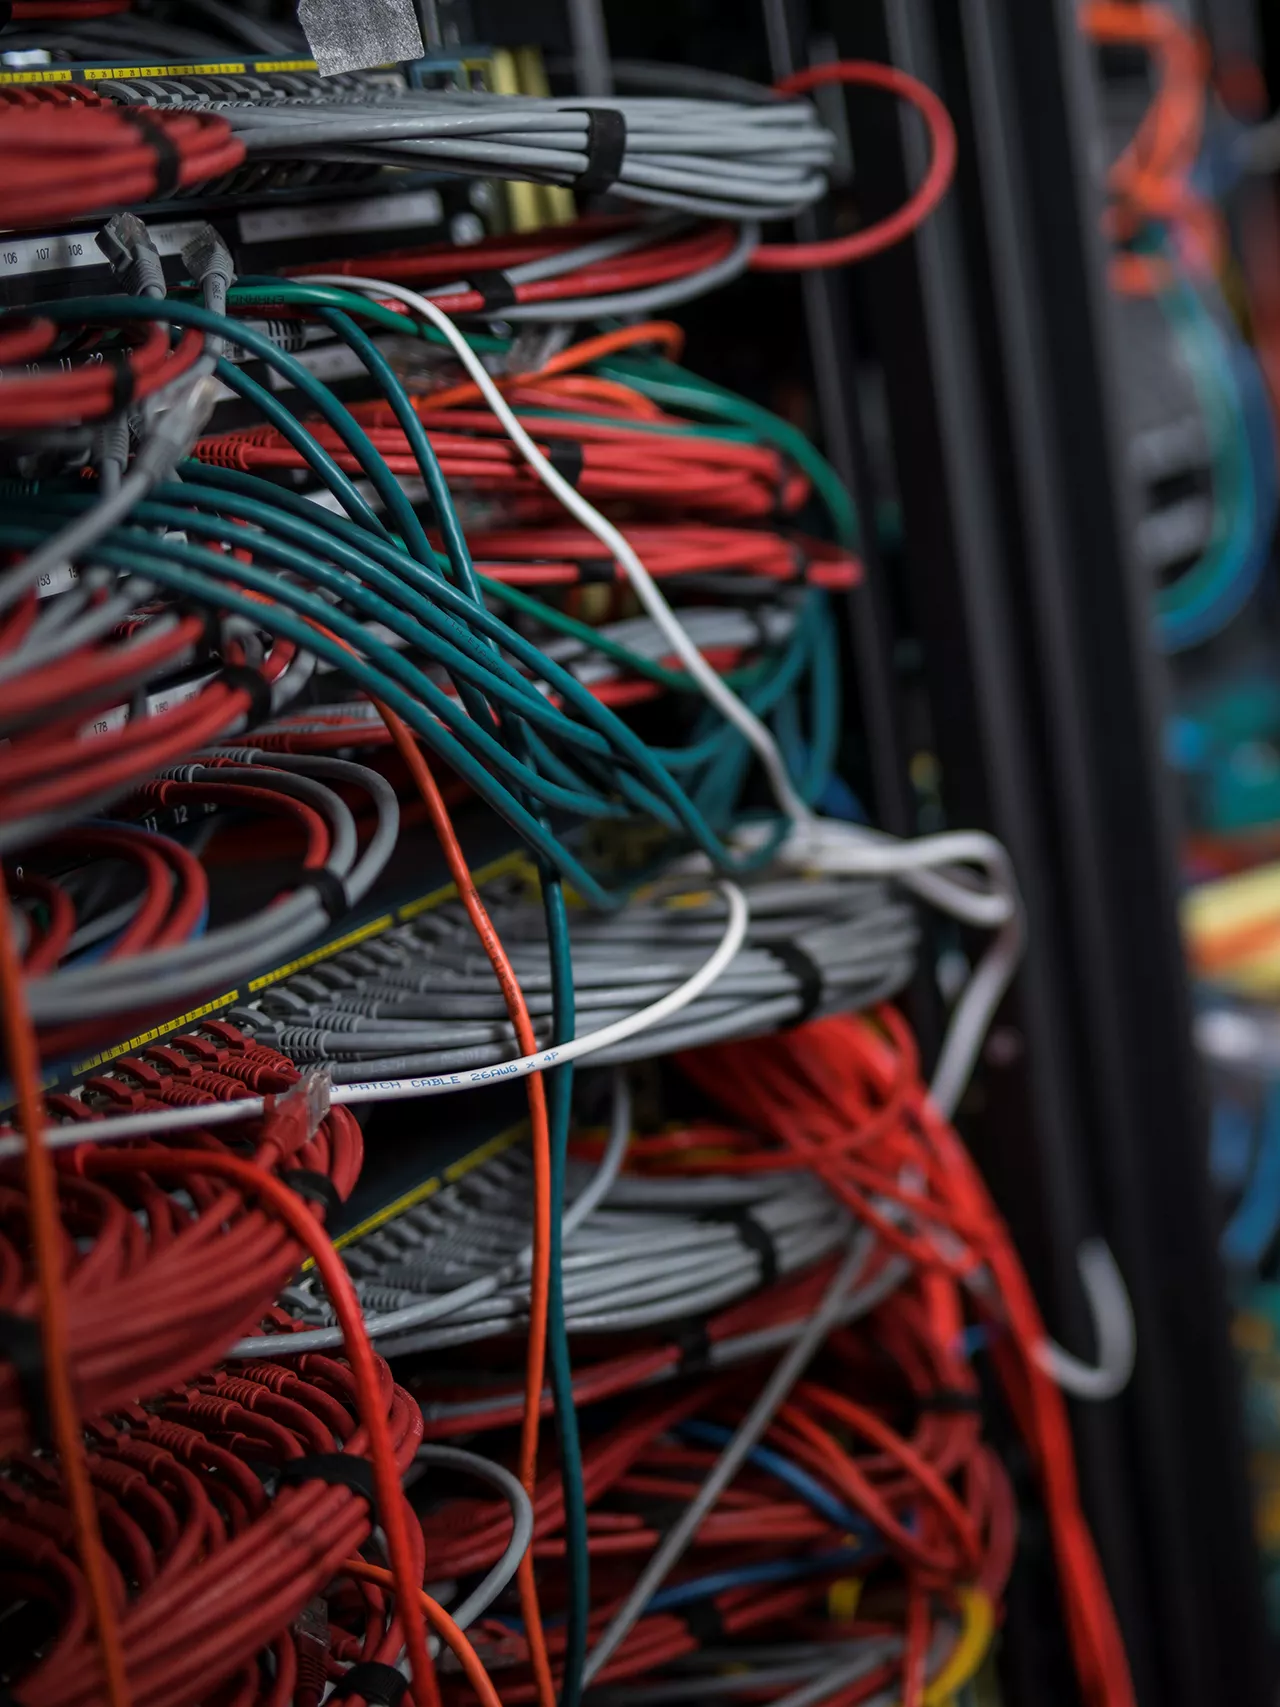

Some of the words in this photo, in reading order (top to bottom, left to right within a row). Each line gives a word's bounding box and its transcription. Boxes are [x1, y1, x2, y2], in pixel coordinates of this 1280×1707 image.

[2, 252, 18, 265] 106
[35, 247, 50, 260] 107
[68, 244, 83, 257] 108
[59, 357, 72, 373] 11
[36, 573, 51, 587] 153
[68, 566, 79, 579] 15
[93, 721, 108, 734] 178
[145, 816, 158, 833] 11
[173, 805, 189, 824] 12
[348, 1081, 401, 1091] PATCH
[411, 1071, 461, 1088] CABLE
[471, 1063, 518, 1082] 26AWG
[543, 1051, 559, 1062] 4P
